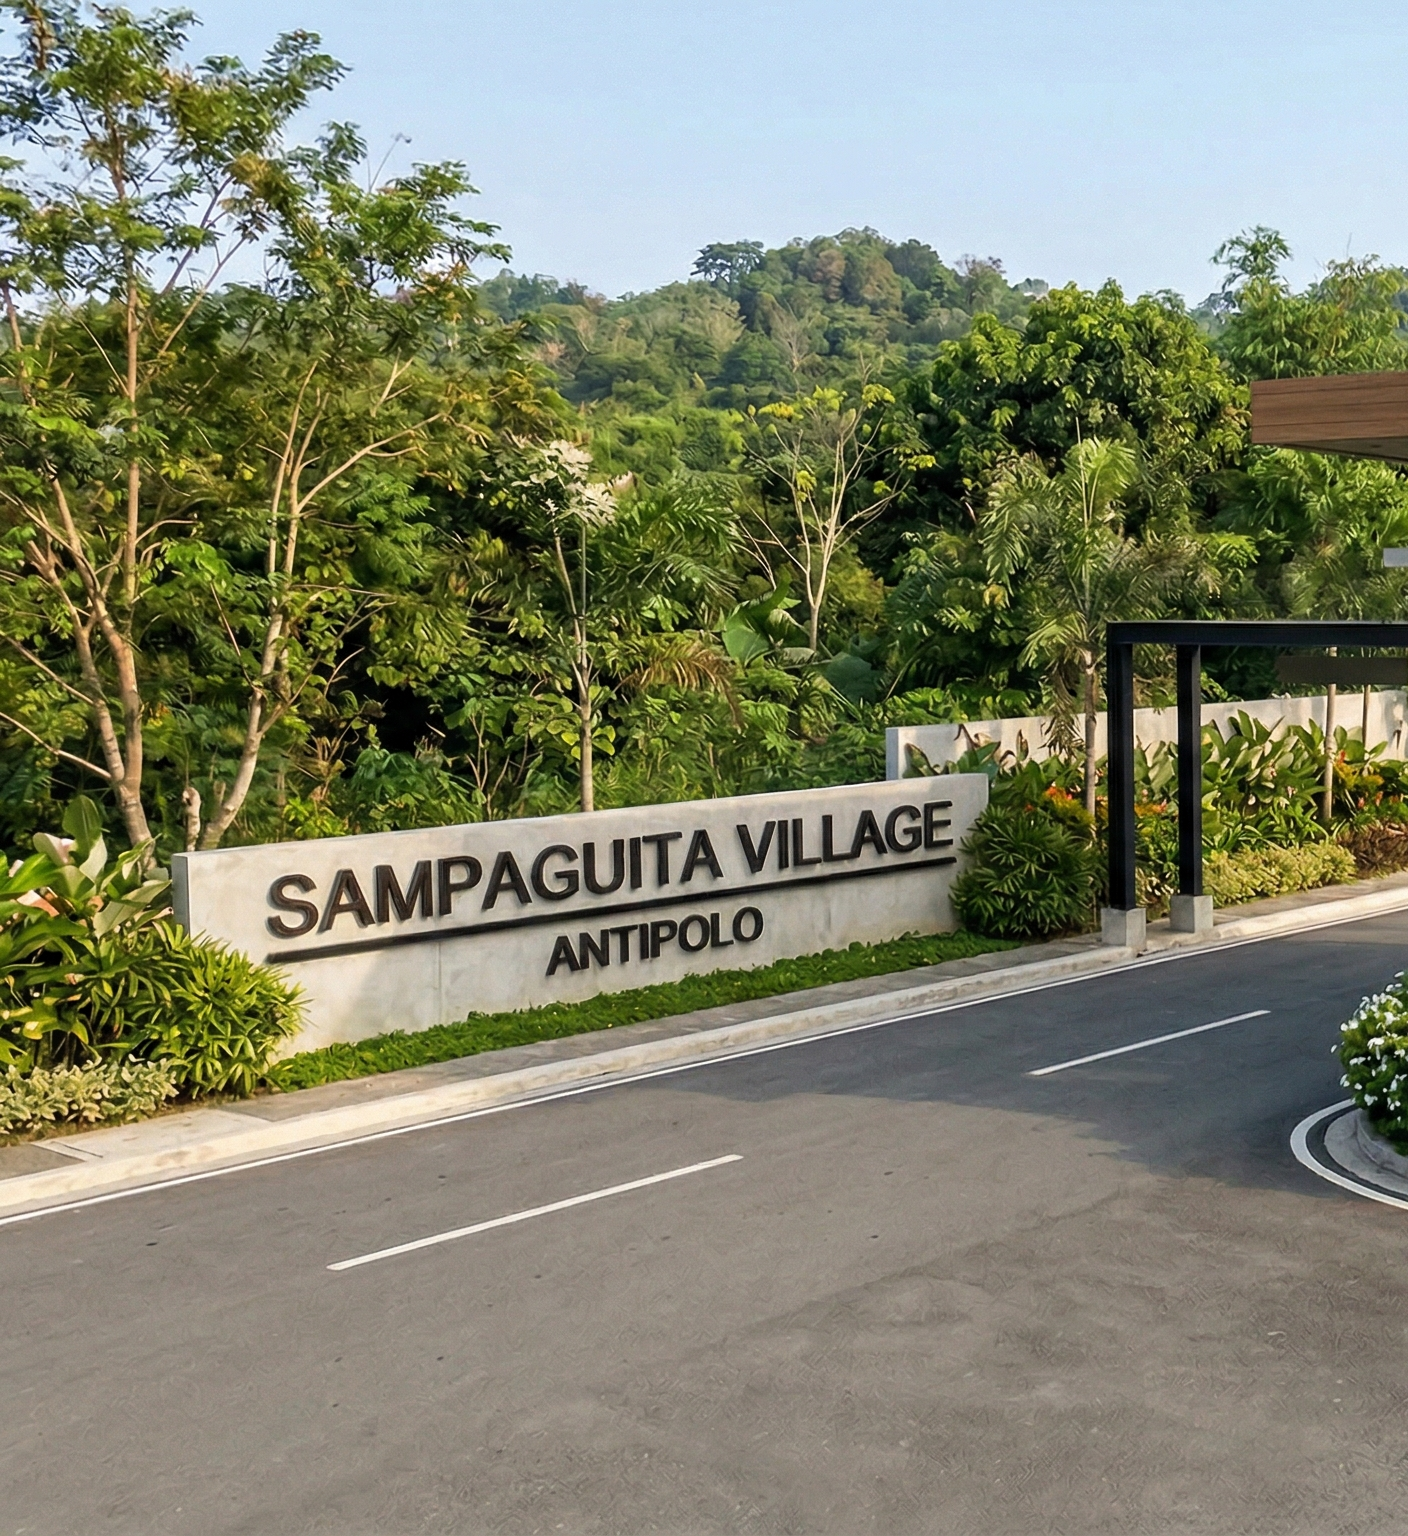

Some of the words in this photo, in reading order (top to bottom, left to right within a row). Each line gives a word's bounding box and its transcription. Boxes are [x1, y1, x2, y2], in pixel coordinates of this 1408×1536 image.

[266, 829, 724, 939] SAMPAGUITA
[736, 800, 954, 874] VILLAGE
[545, 906, 764, 976] ANTIPOLO
